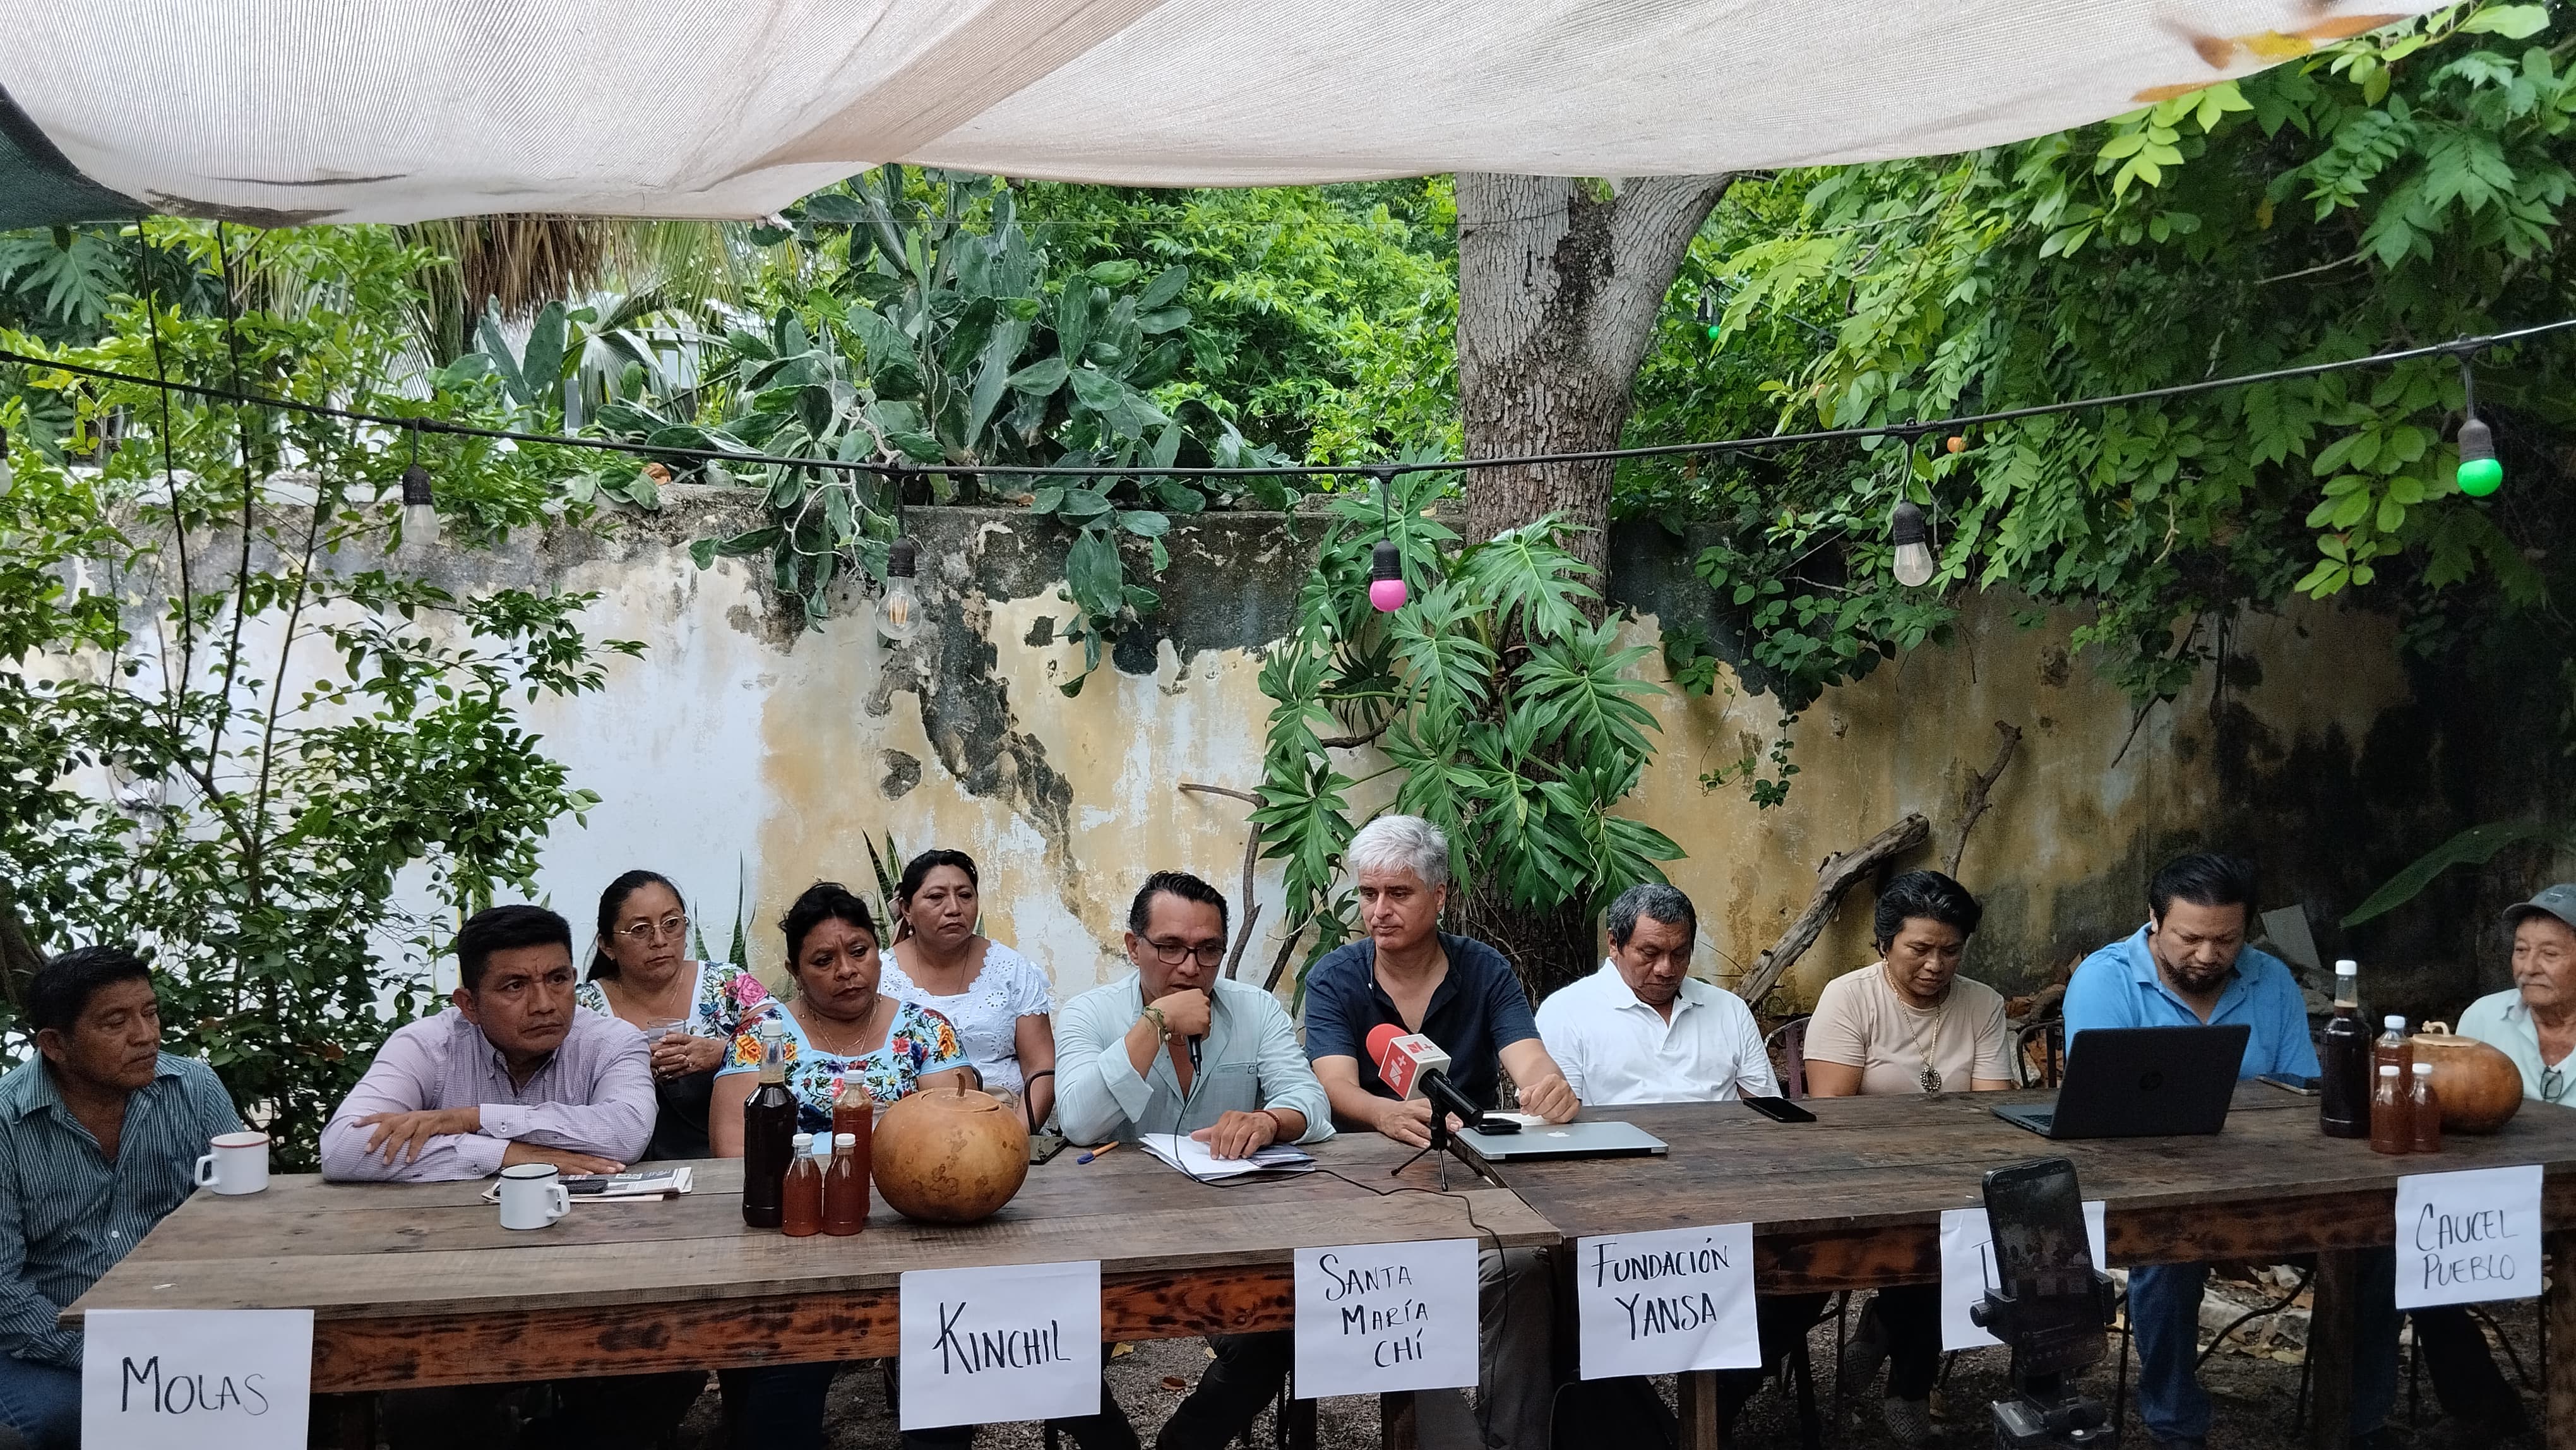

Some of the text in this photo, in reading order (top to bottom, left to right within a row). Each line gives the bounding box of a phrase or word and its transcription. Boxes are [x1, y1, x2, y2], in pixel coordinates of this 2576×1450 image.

[2416, 1202, 2519, 1251] CAUCEL
[1319, 1254, 1413, 1302] SANTA
[1591, 1237, 1731, 1288] FUNDACIÓN
[2423, 1253, 2515, 1290] PUEBLO
[932, 1301, 1071, 1374] KINCHIL
[1341, 1298, 1429, 1335] MARÍA
[1614, 1293, 1718, 1341] YANSA
[1374, 1327, 1423, 1368] CHÍ
[121, 1355, 269, 1416] MOLAS
